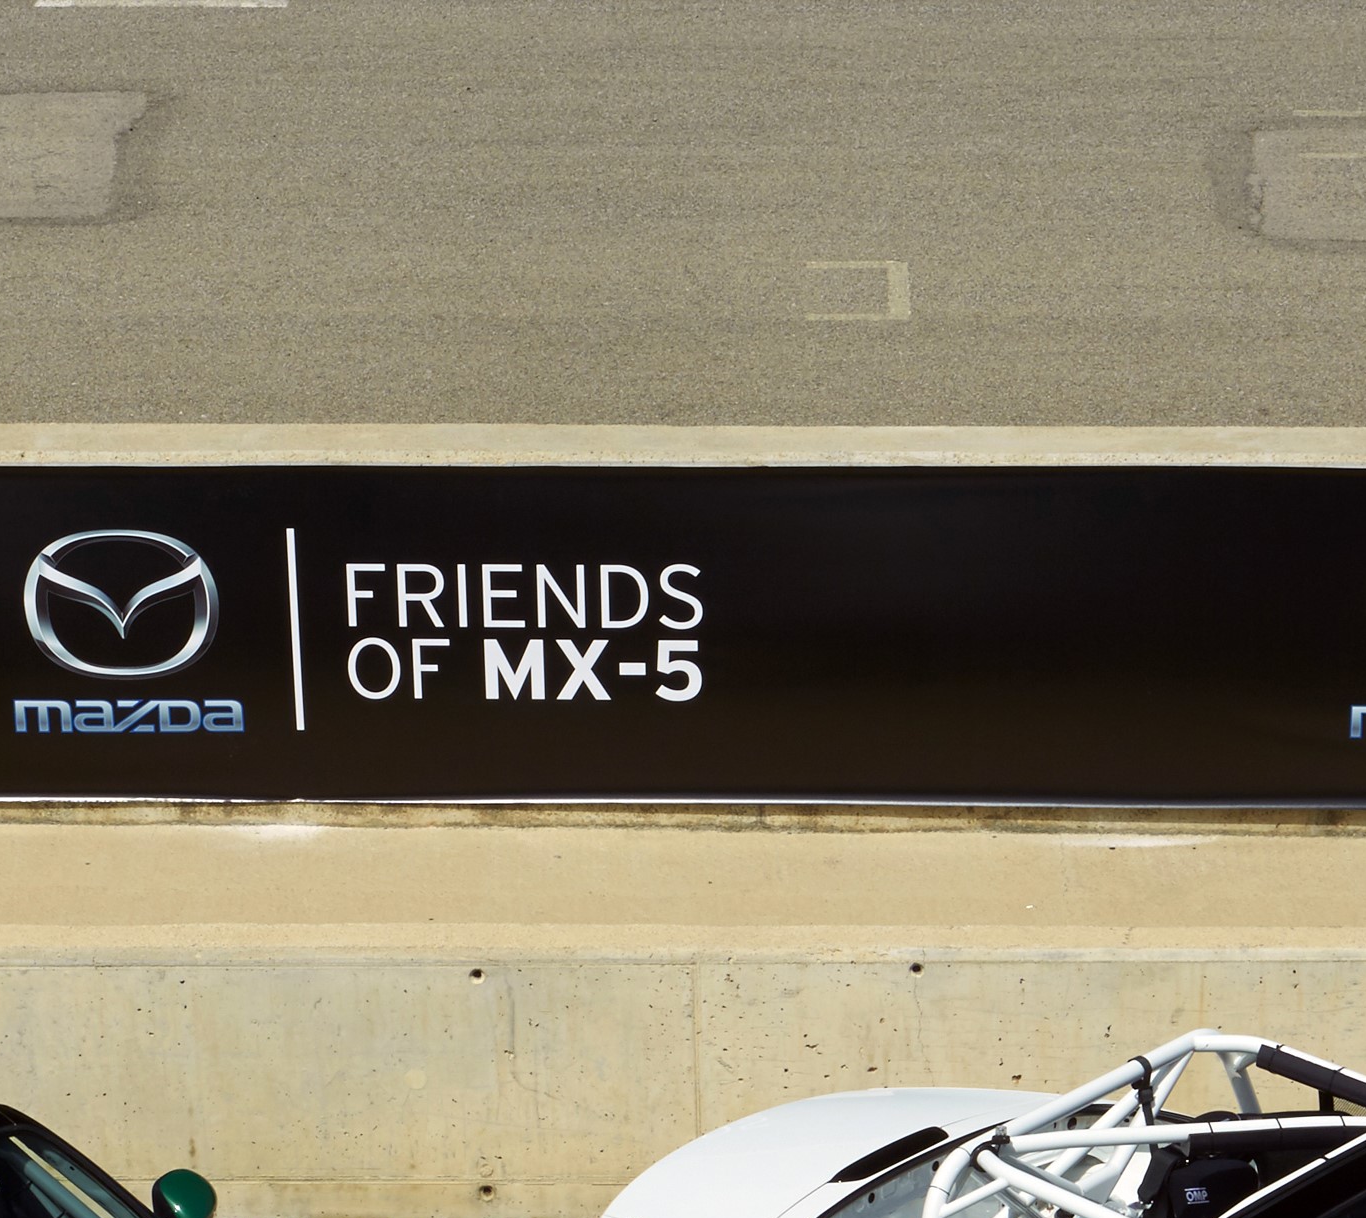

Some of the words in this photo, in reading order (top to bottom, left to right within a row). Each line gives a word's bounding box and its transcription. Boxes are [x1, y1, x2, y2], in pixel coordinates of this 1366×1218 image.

[345, 563, 704, 630] FRIENDS
[347, 637, 450, 700] OF
[484, 638, 703, 702] MX-5
